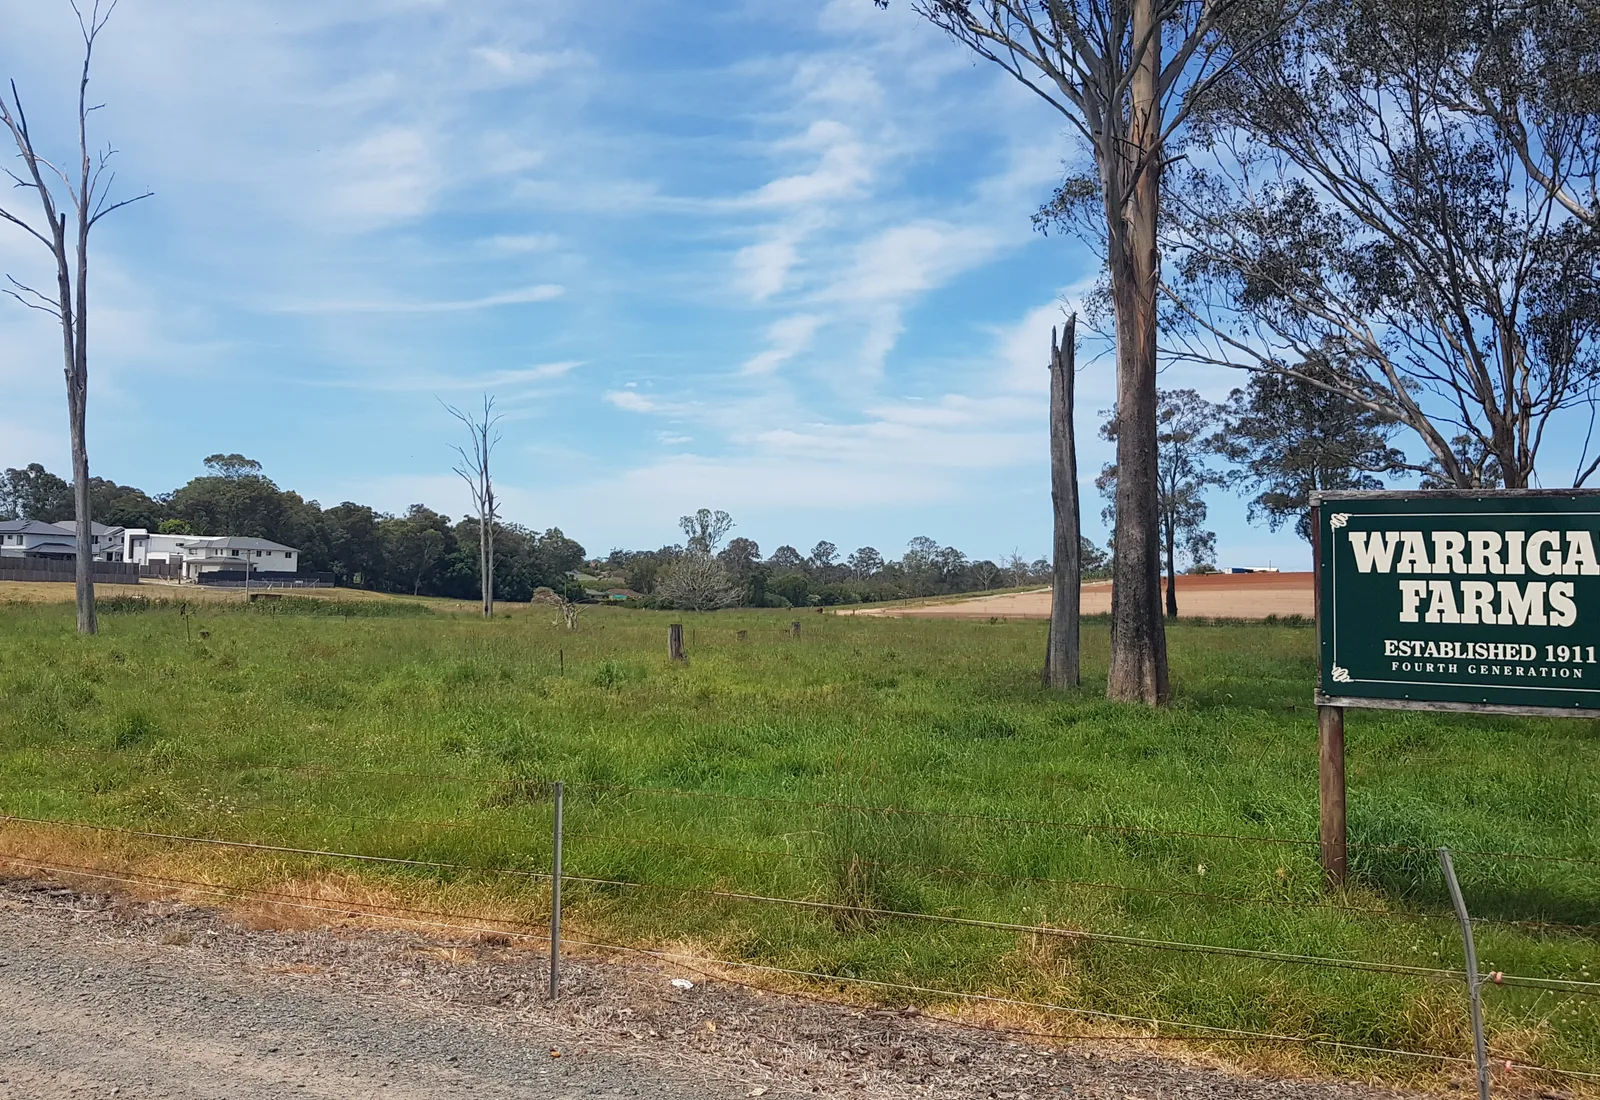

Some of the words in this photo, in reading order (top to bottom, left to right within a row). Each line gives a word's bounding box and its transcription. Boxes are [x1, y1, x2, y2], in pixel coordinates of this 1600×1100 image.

[1399, 580, 1577, 628] FARMS
[1384, 639, 1537, 661] ESTABLISHED
[1545, 644, 1597, 664] 1911
[1391, 661, 1458, 674] FOURTH
[1467, 664, 1583, 679] GENERATION
